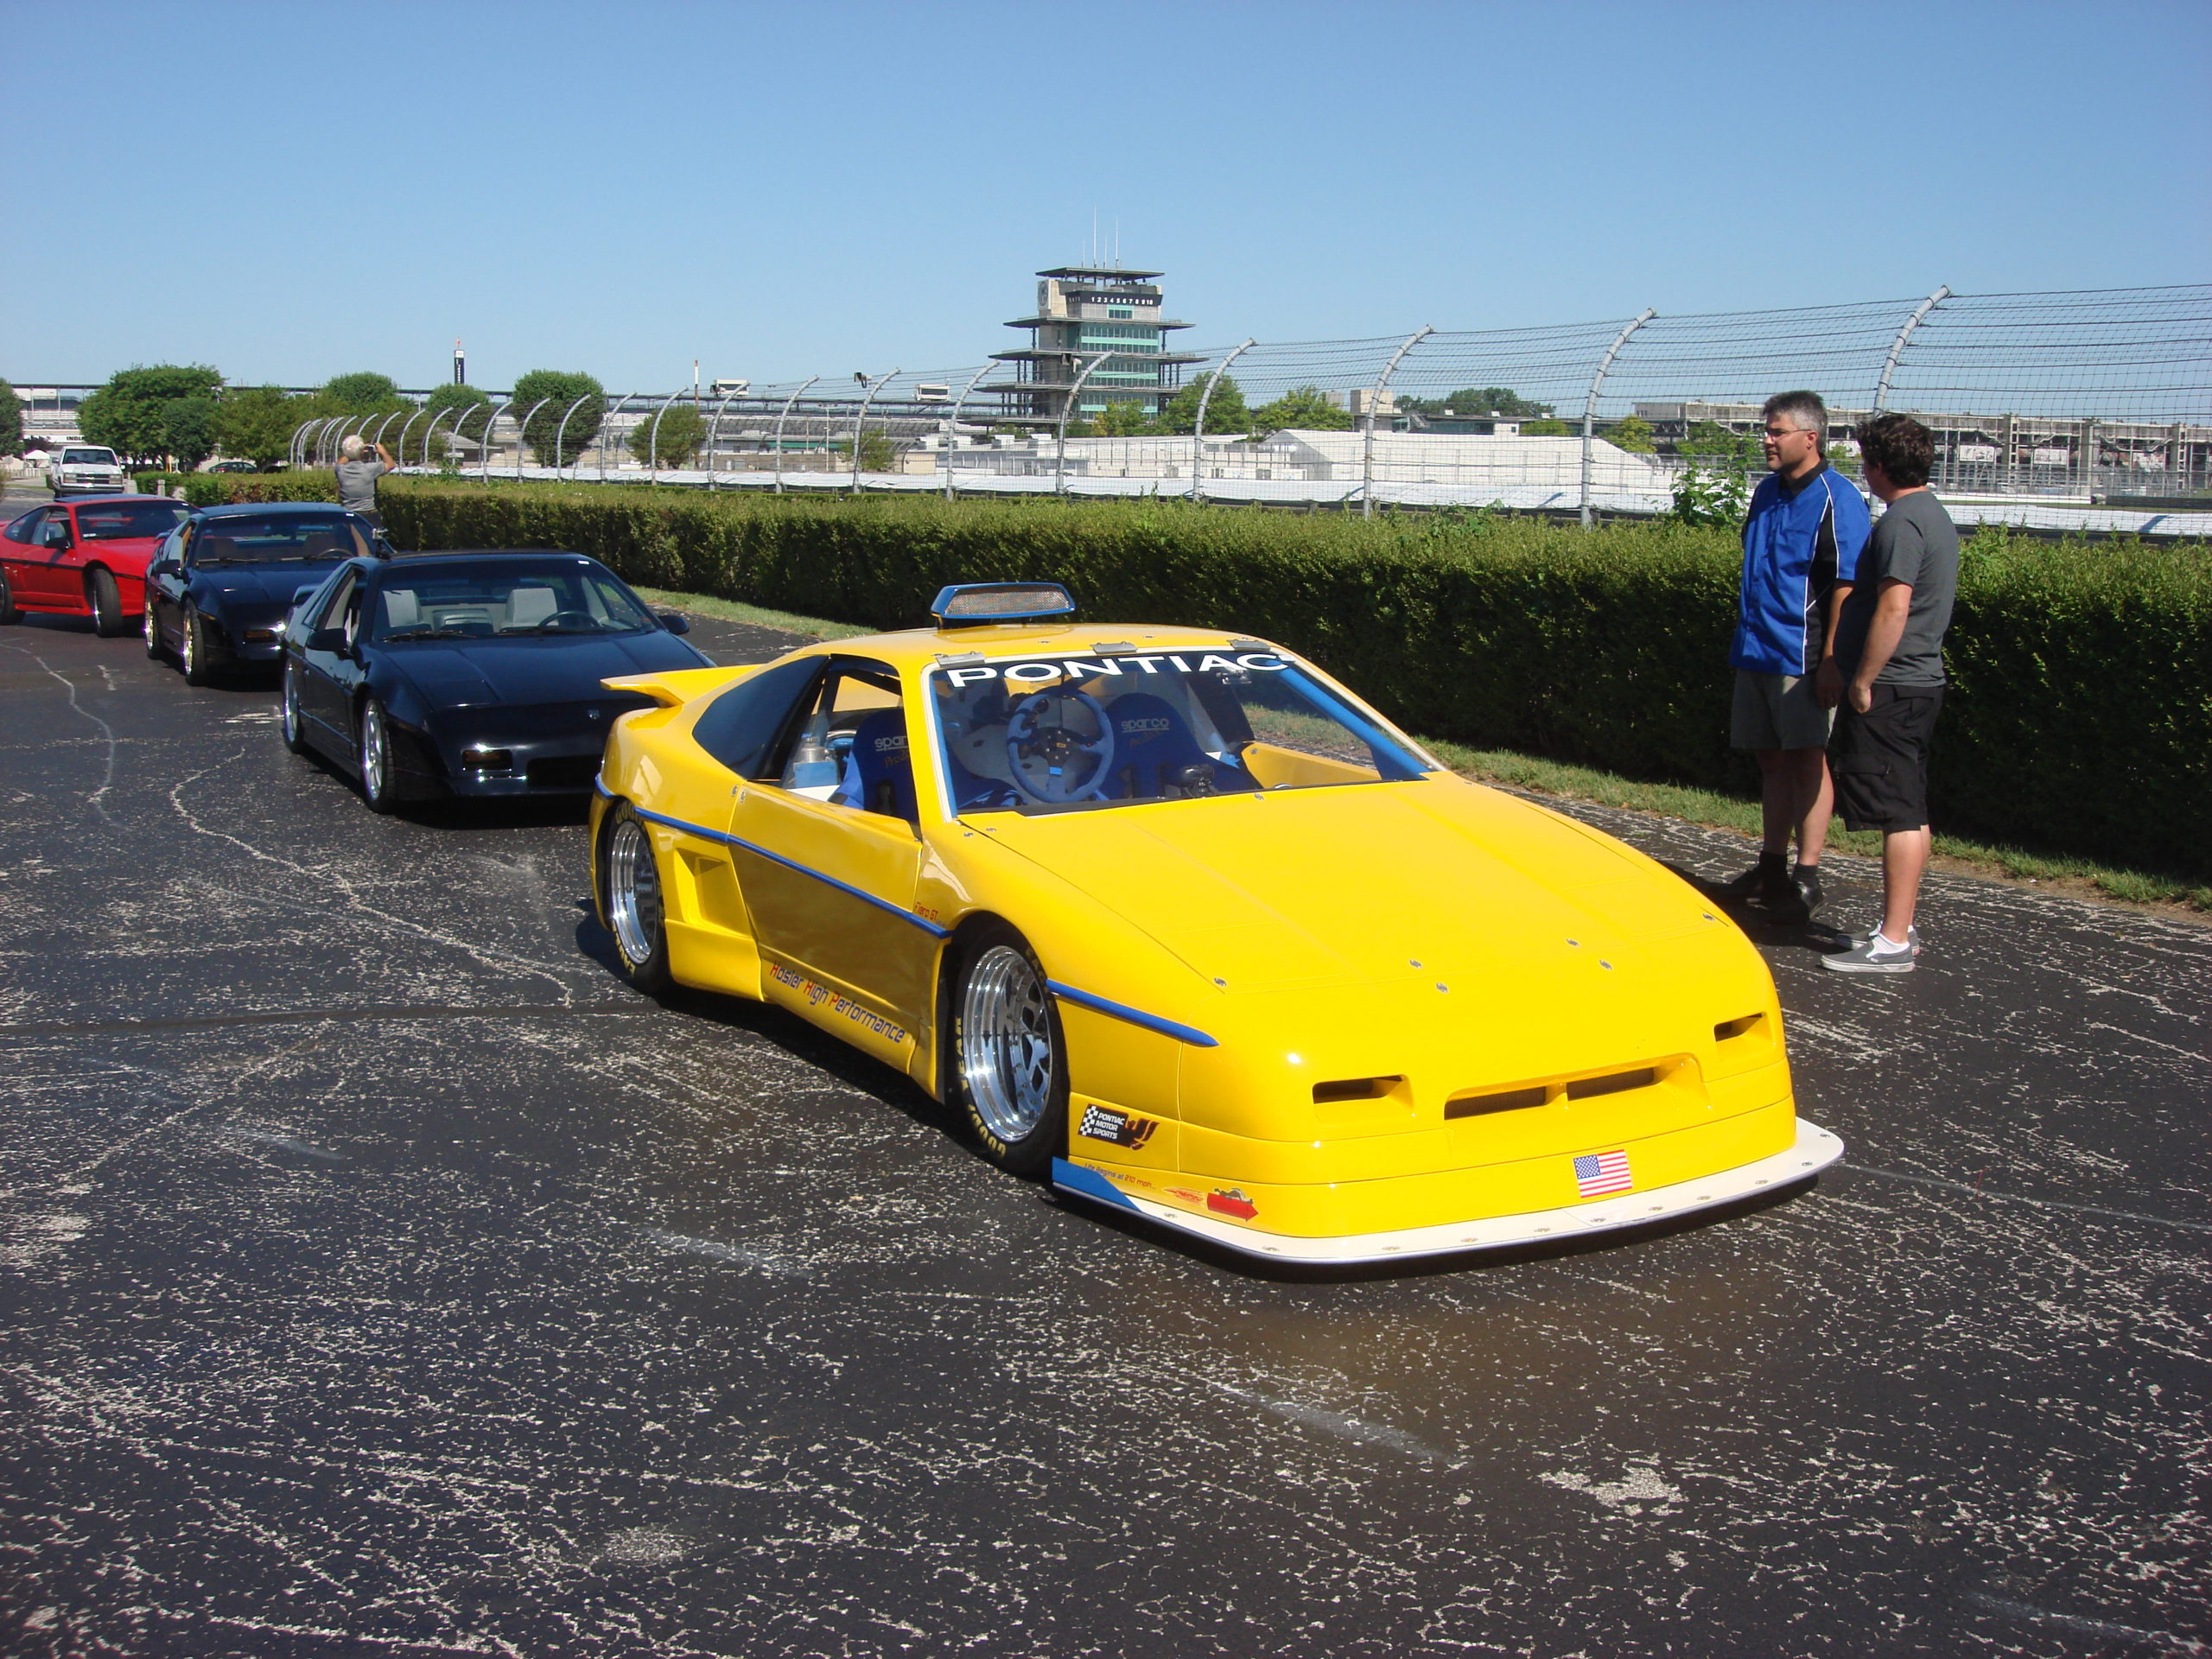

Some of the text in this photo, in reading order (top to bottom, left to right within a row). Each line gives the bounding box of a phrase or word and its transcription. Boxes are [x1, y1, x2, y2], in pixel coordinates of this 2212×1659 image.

[946, 653, 1288, 688] PONTIAC
[770, 960, 906, 1044] Hosler High Performance
[1097, 1113, 1125, 1125] PONTIAC
[1095, 1120, 1118, 1131] MOTOR
[1092, 1128, 1118, 1139] SPORTS
